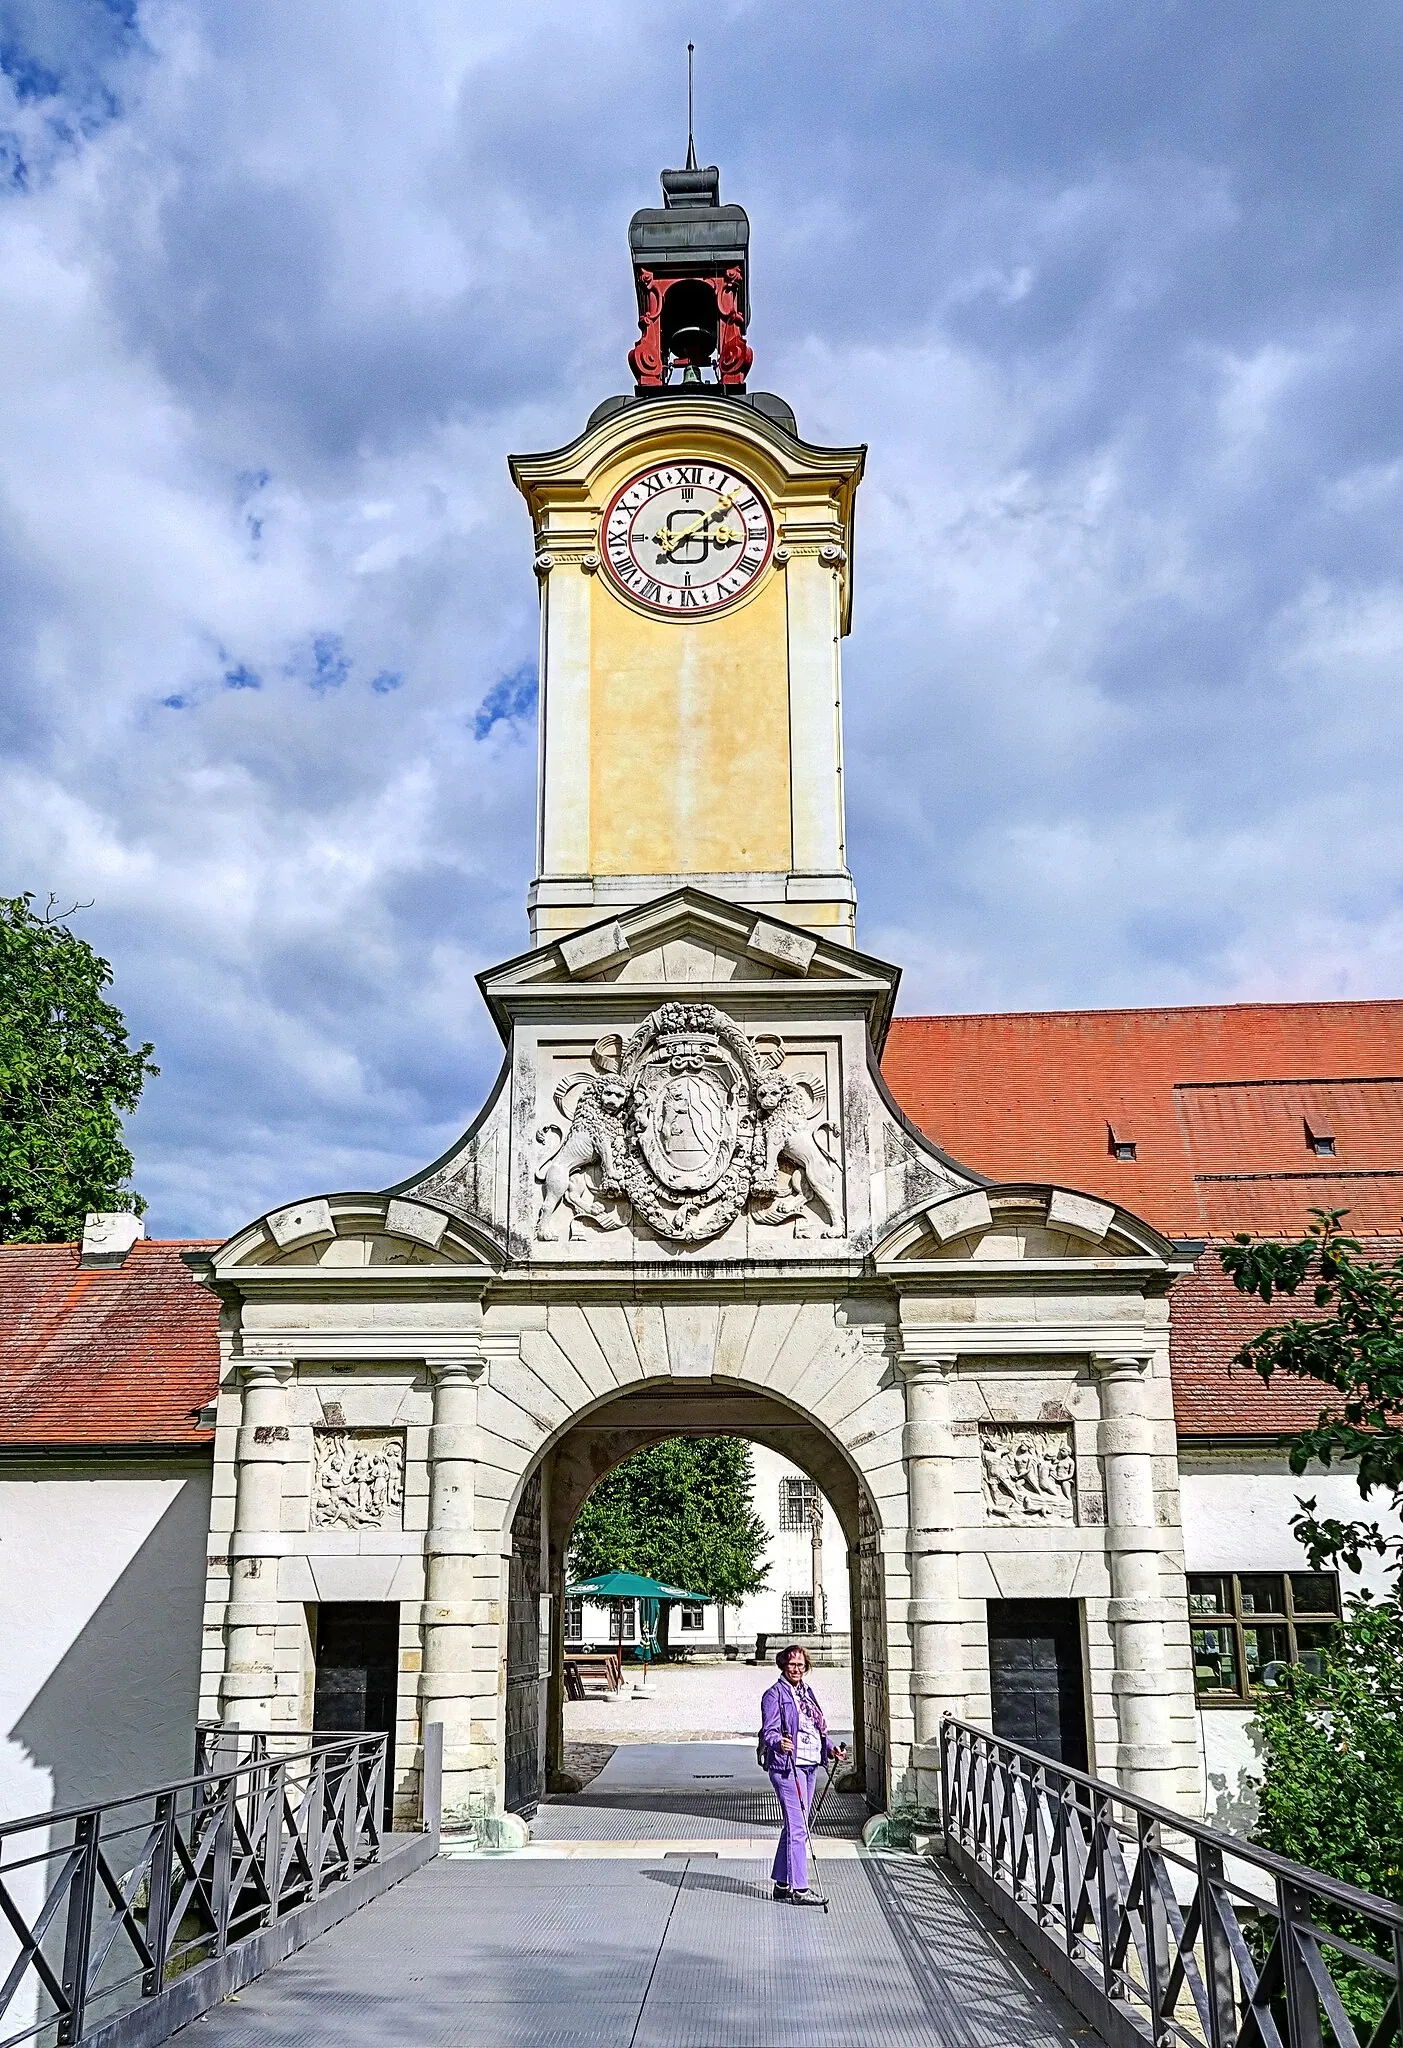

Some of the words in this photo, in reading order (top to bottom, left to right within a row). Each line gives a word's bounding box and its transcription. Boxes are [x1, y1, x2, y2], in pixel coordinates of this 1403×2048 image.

[638, 473, 666, 497] XI
[674, 467, 703, 485] XII
[715, 474, 730, 491] I
[615, 498, 640, 518] X
[737, 496, 759, 512] II
[608, 529, 628, 548] IX
[748, 526, 767, 541] III
[613, 556, 638, 584] VIII
[735, 554, 761, 577] IIII
[638, 579, 661, 603] VII
[680, 590, 699, 606] VI
[716, 582, 734, 600] V
